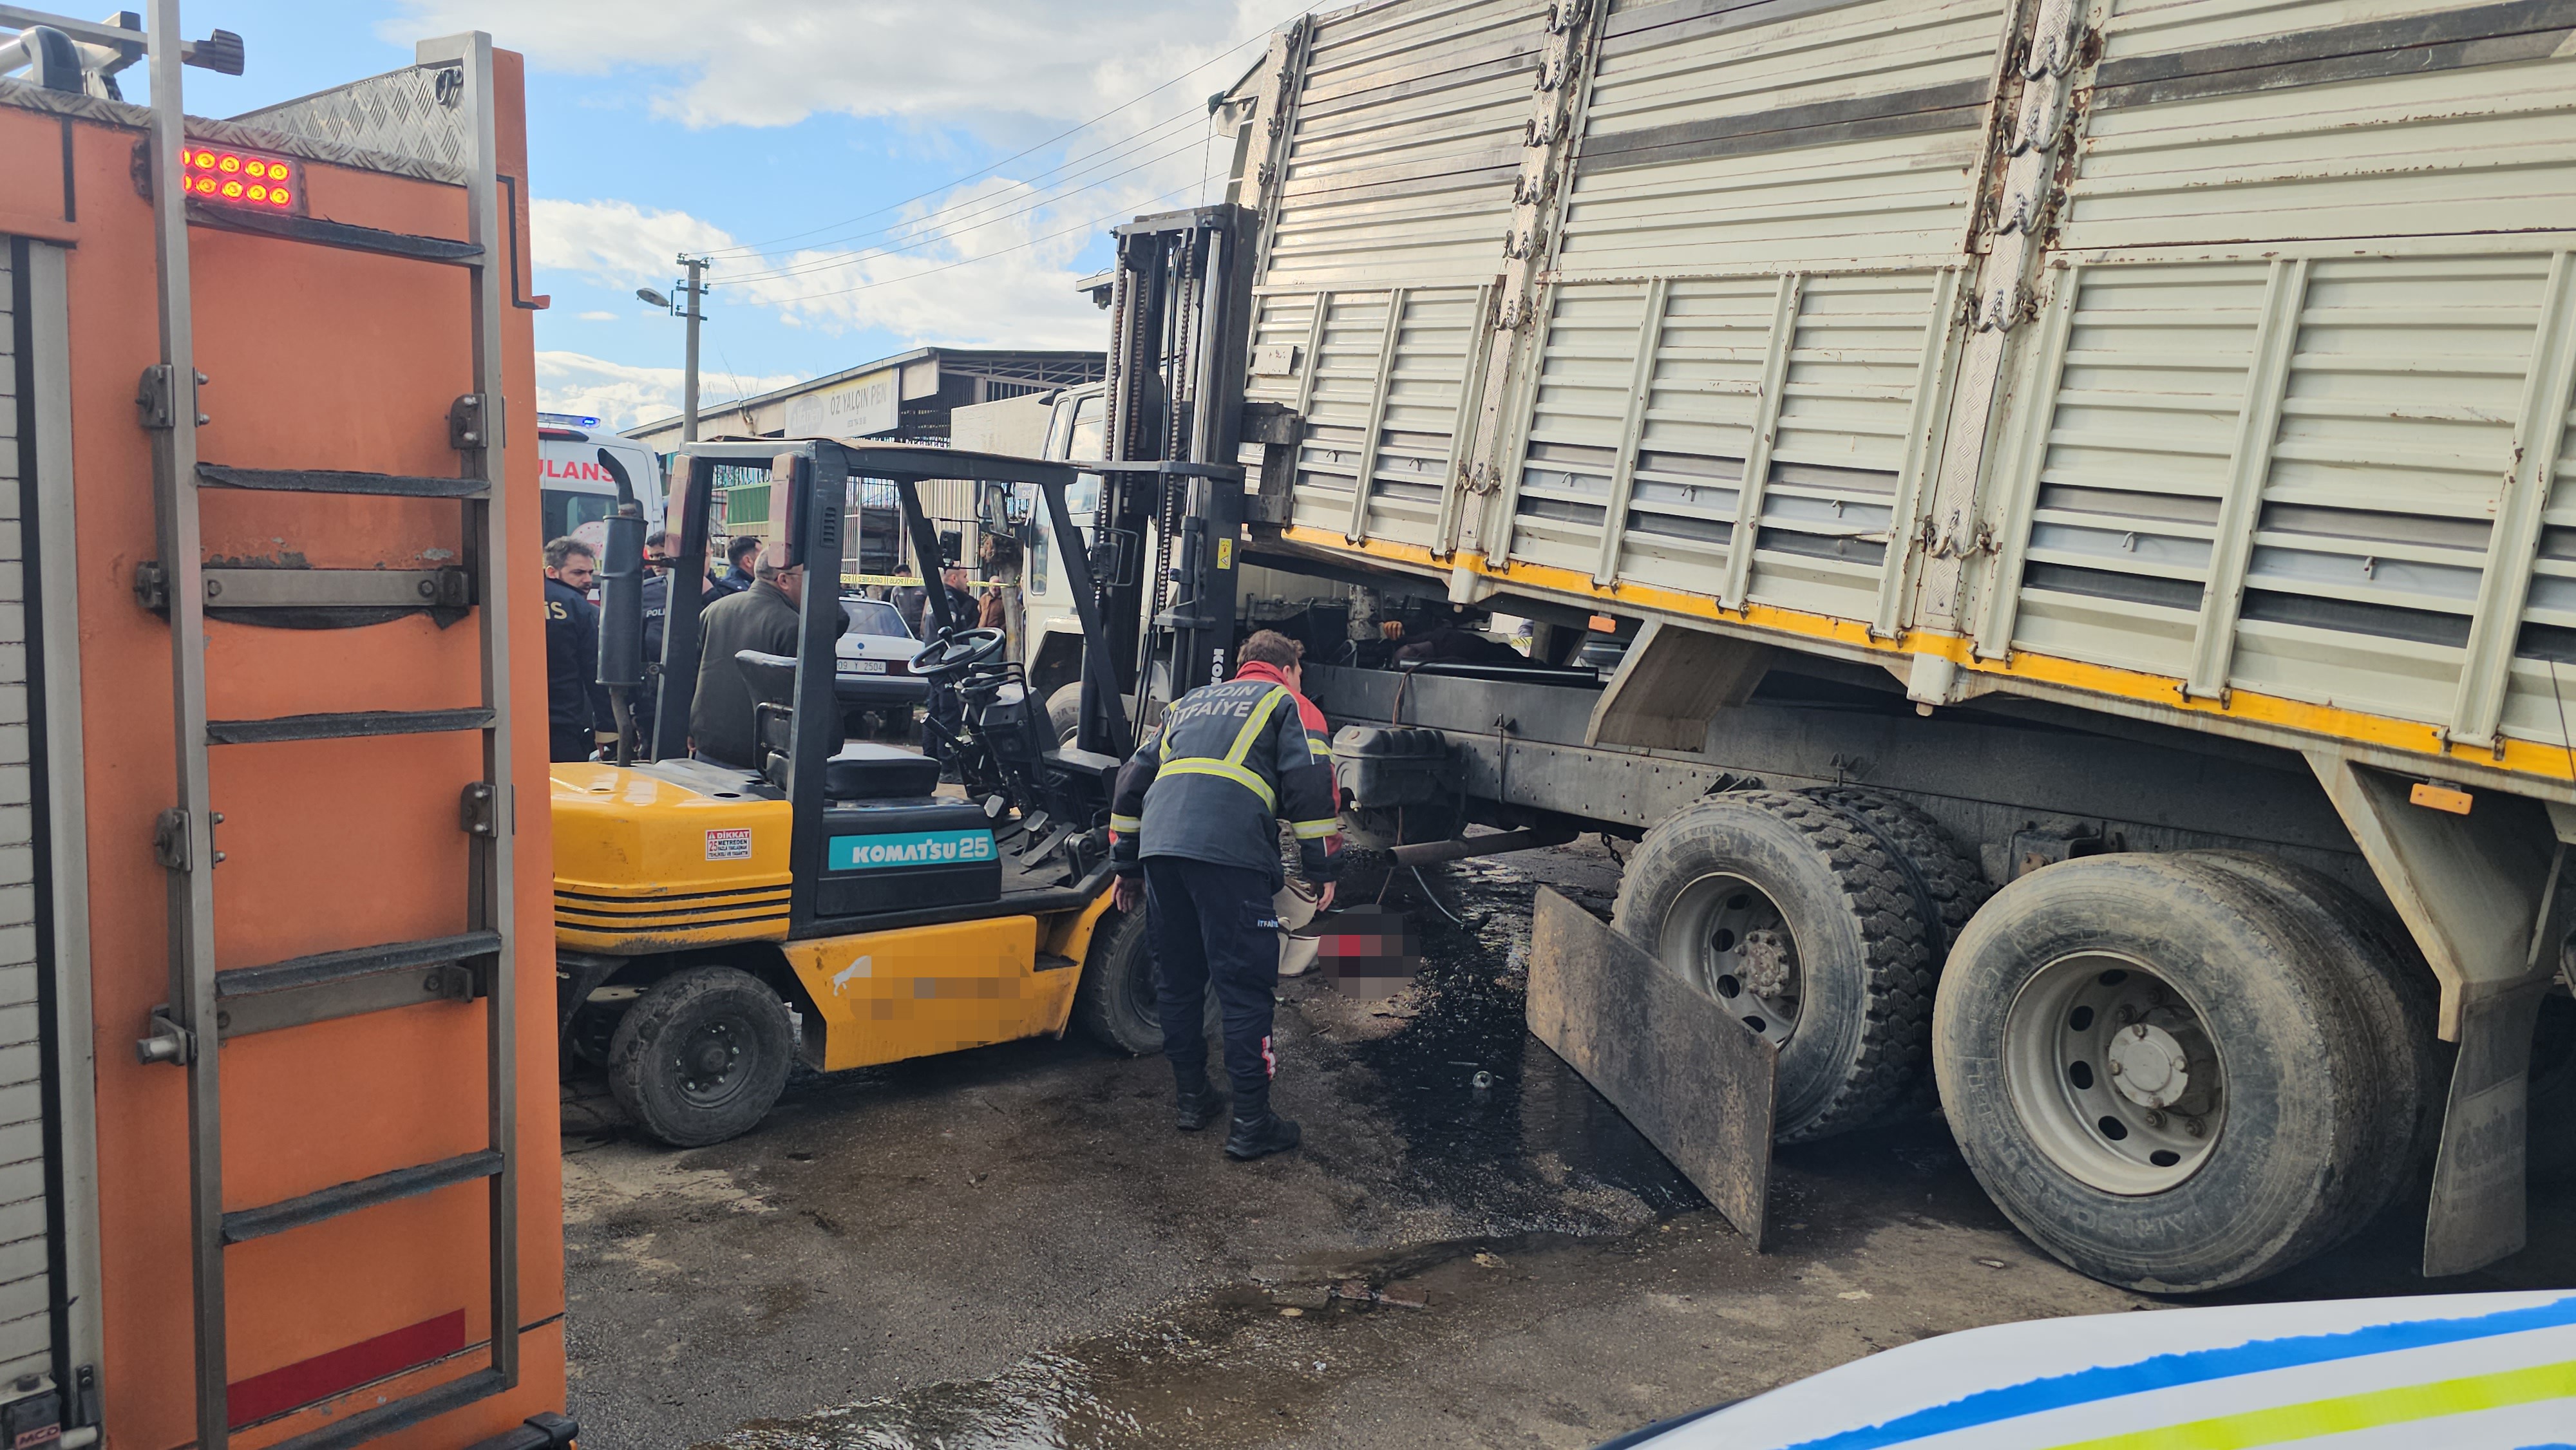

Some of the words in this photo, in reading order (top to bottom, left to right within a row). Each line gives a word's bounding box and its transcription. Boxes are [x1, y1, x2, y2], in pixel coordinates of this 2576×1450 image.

[830, 391, 840, 416] ÖZ
[843, 386, 869, 415] YALÇIN
[871, 381, 887, 406] PEN
[838, 661, 848, 670] 09
[854, 661, 858, 670] Y
[864, 662, 883, 671] 2504
[1186, 685, 1260, 701] AYDIN
[1171, 698, 1253, 728] İTFAİYE
[717, 831, 749, 839] DİKKAT
[709, 841, 717, 851] 25
[852, 838, 956, 863] KOMATSU
[959, 836, 989, 858] 25
